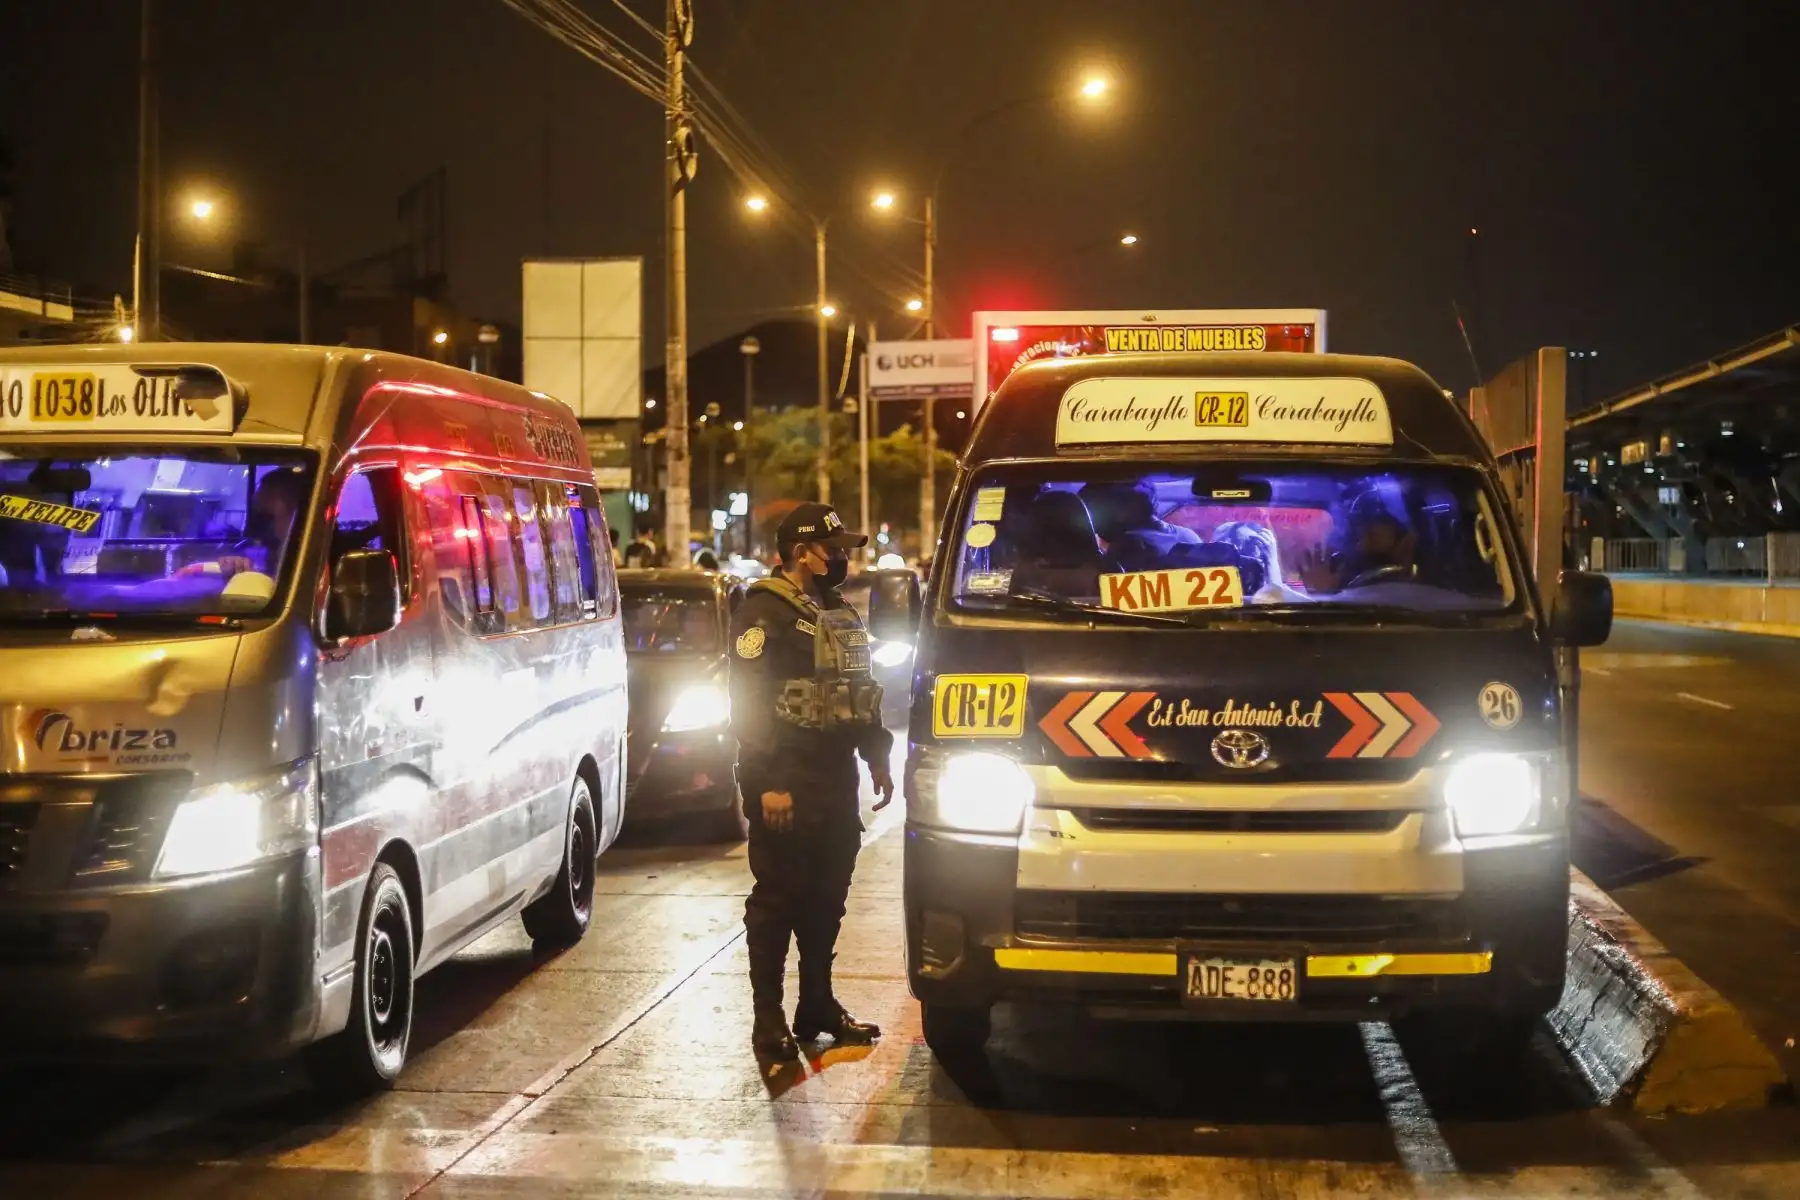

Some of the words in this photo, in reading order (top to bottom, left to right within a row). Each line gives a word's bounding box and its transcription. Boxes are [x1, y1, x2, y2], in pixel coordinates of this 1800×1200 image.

[1107, 329, 1160, 351] VENTA
[1162, 329, 1184, 351] DE
[1187, 327, 1264, 351] MUEBLES
[896, 354, 934, 369] UCH
[34, 378, 94, 417] 1038
[1066, 395, 1188, 431] Carabayllo
[1199, 396, 1245, 423] CR-12
[1255, 395, 1377, 432] Carabayllo
[18, 500, 96, 530] FELIPE
[1109, 572, 1172, 609] KM
[1185, 569, 1234, 605] 22
[941, 682, 1016, 728] CR-12
[1175, 699, 1209, 727] San
[1212, 699, 1283, 727] Antonio
[1485, 689, 1515, 721] 26
[1191, 966, 1292, 998] ADE-888
